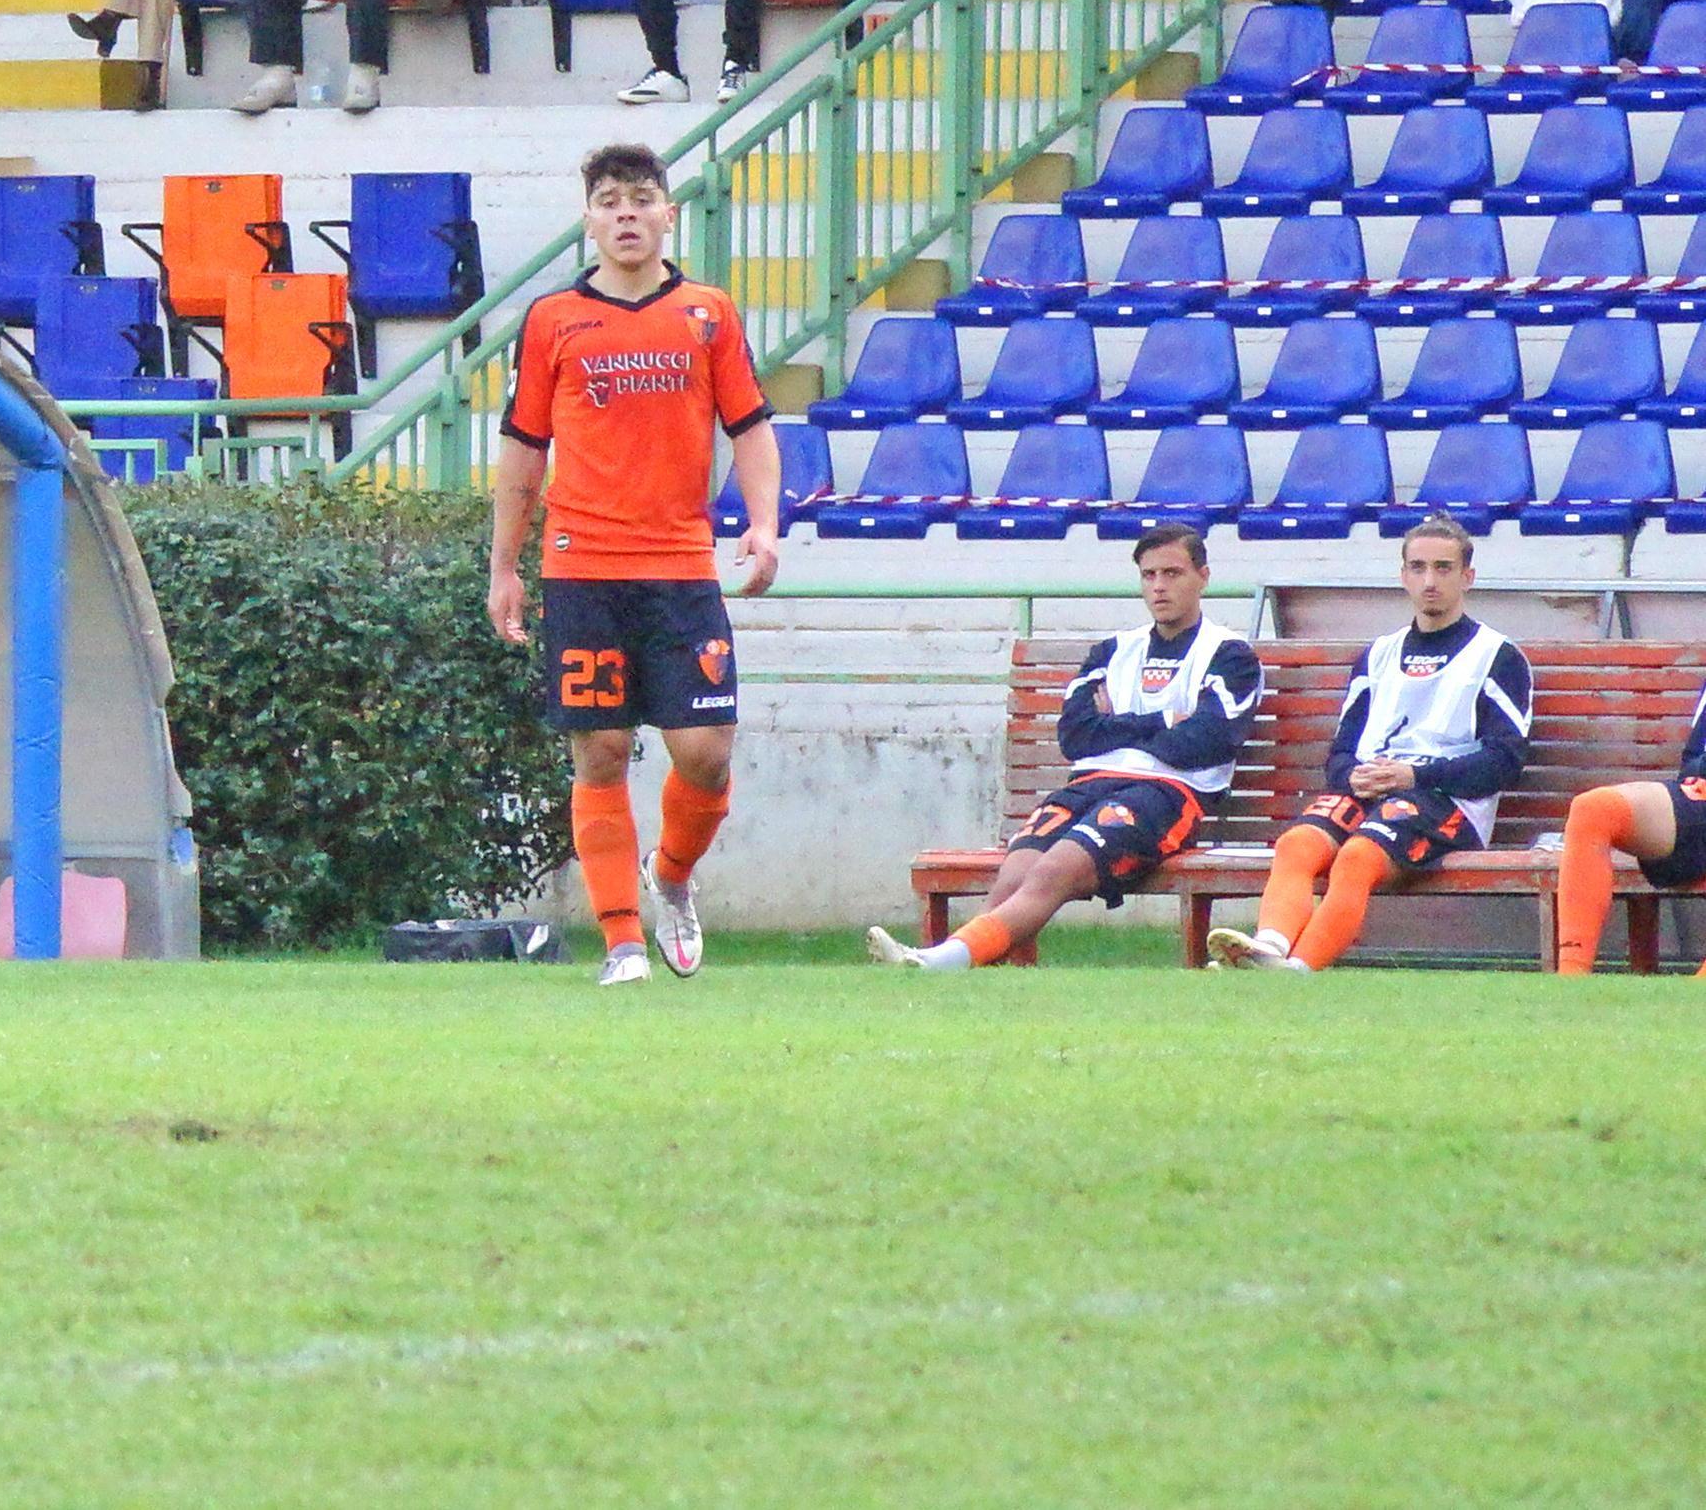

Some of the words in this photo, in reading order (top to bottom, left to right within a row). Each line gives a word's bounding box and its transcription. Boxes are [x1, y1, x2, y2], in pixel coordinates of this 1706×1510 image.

[580, 351, 692, 374] VANNUCCI
[560, 648, 626, 708] 23
[691, 695, 735, 709] LEGEA
